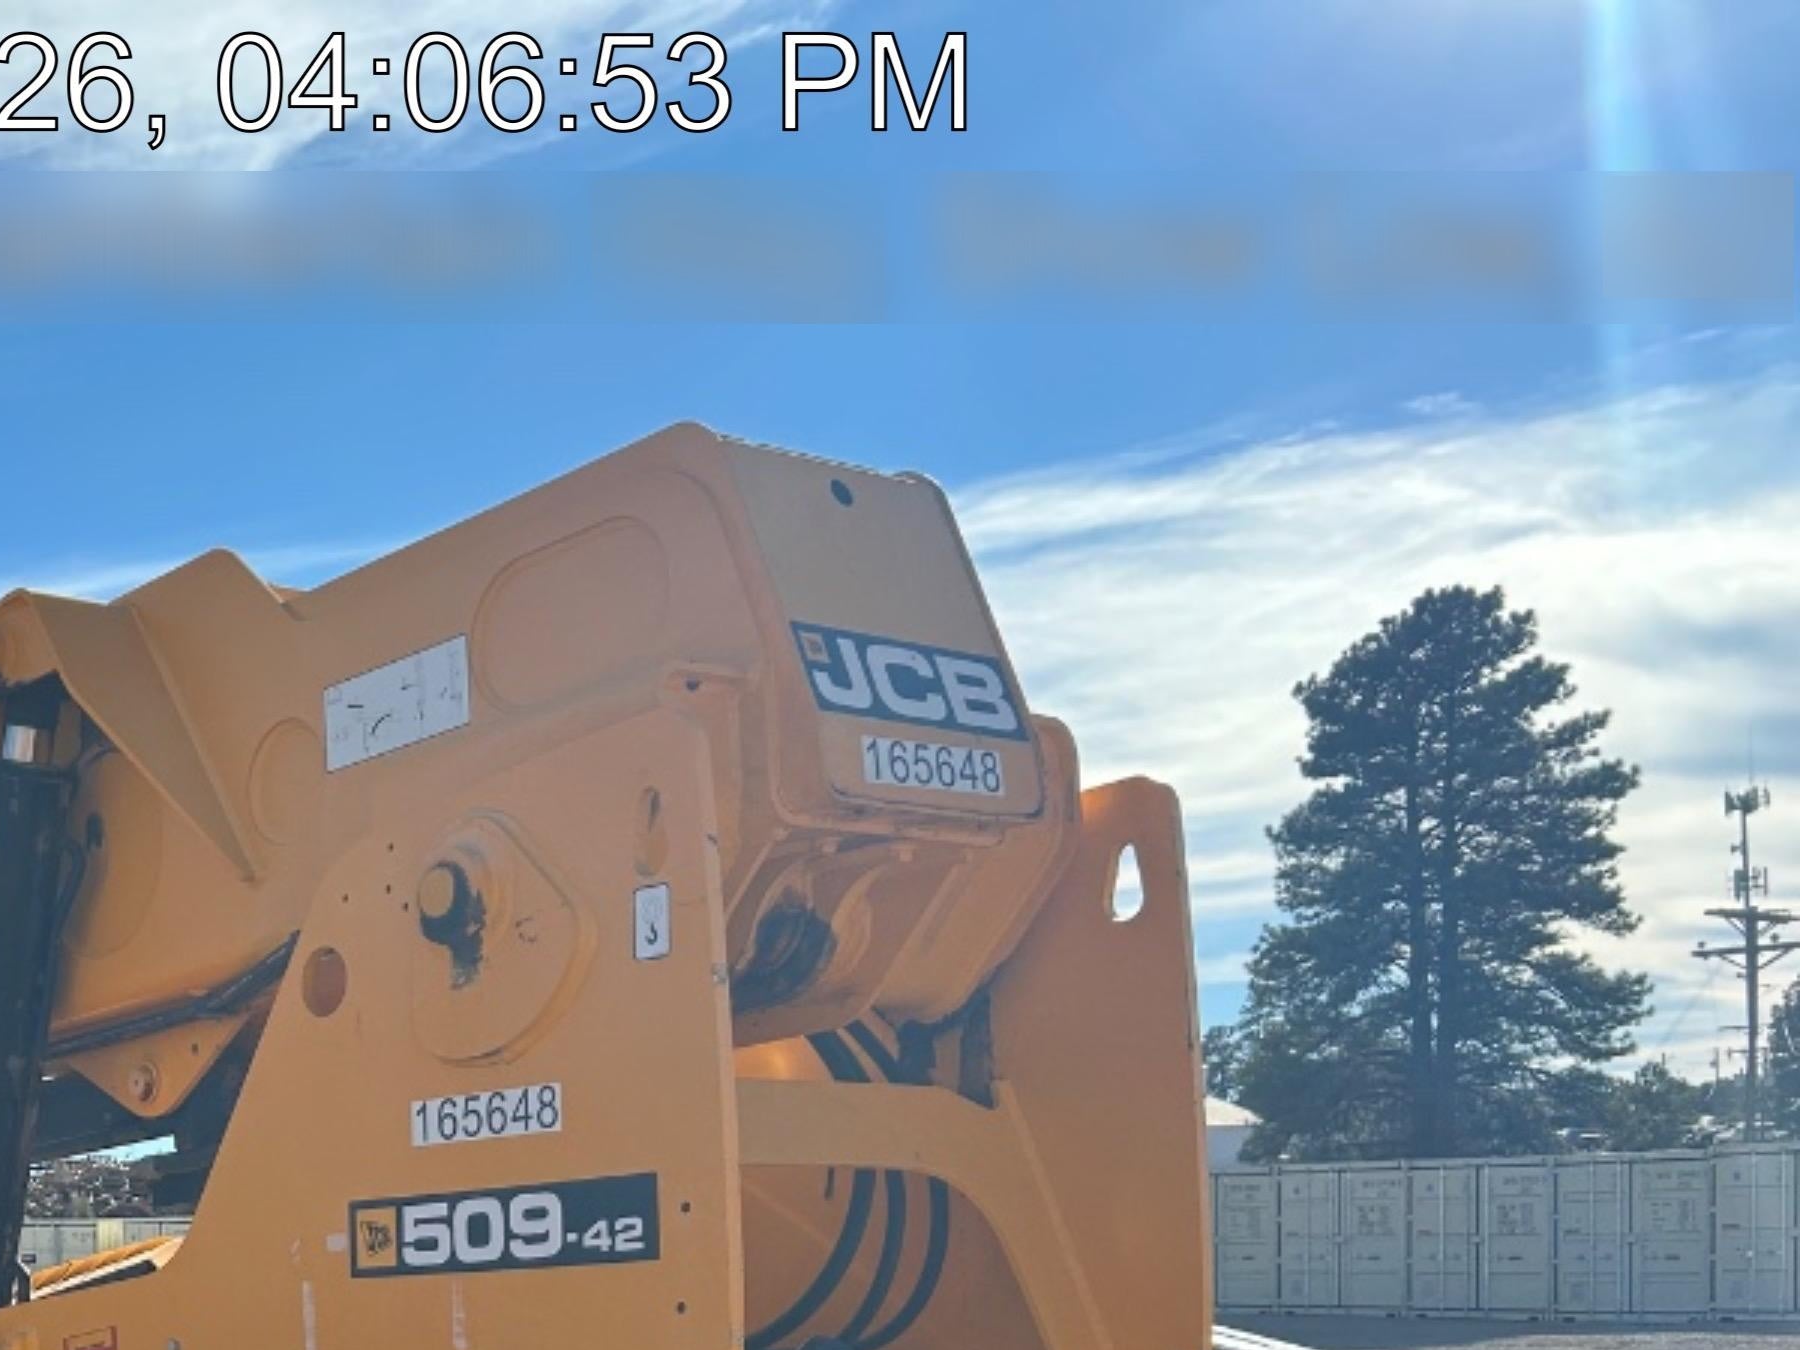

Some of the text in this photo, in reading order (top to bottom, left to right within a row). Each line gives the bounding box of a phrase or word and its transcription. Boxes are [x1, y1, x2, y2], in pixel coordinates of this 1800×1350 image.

[811, 637, 1018, 730] JCB
[866, 737, 1000, 793] 165648
[416, 1085, 559, 1143] 165648
